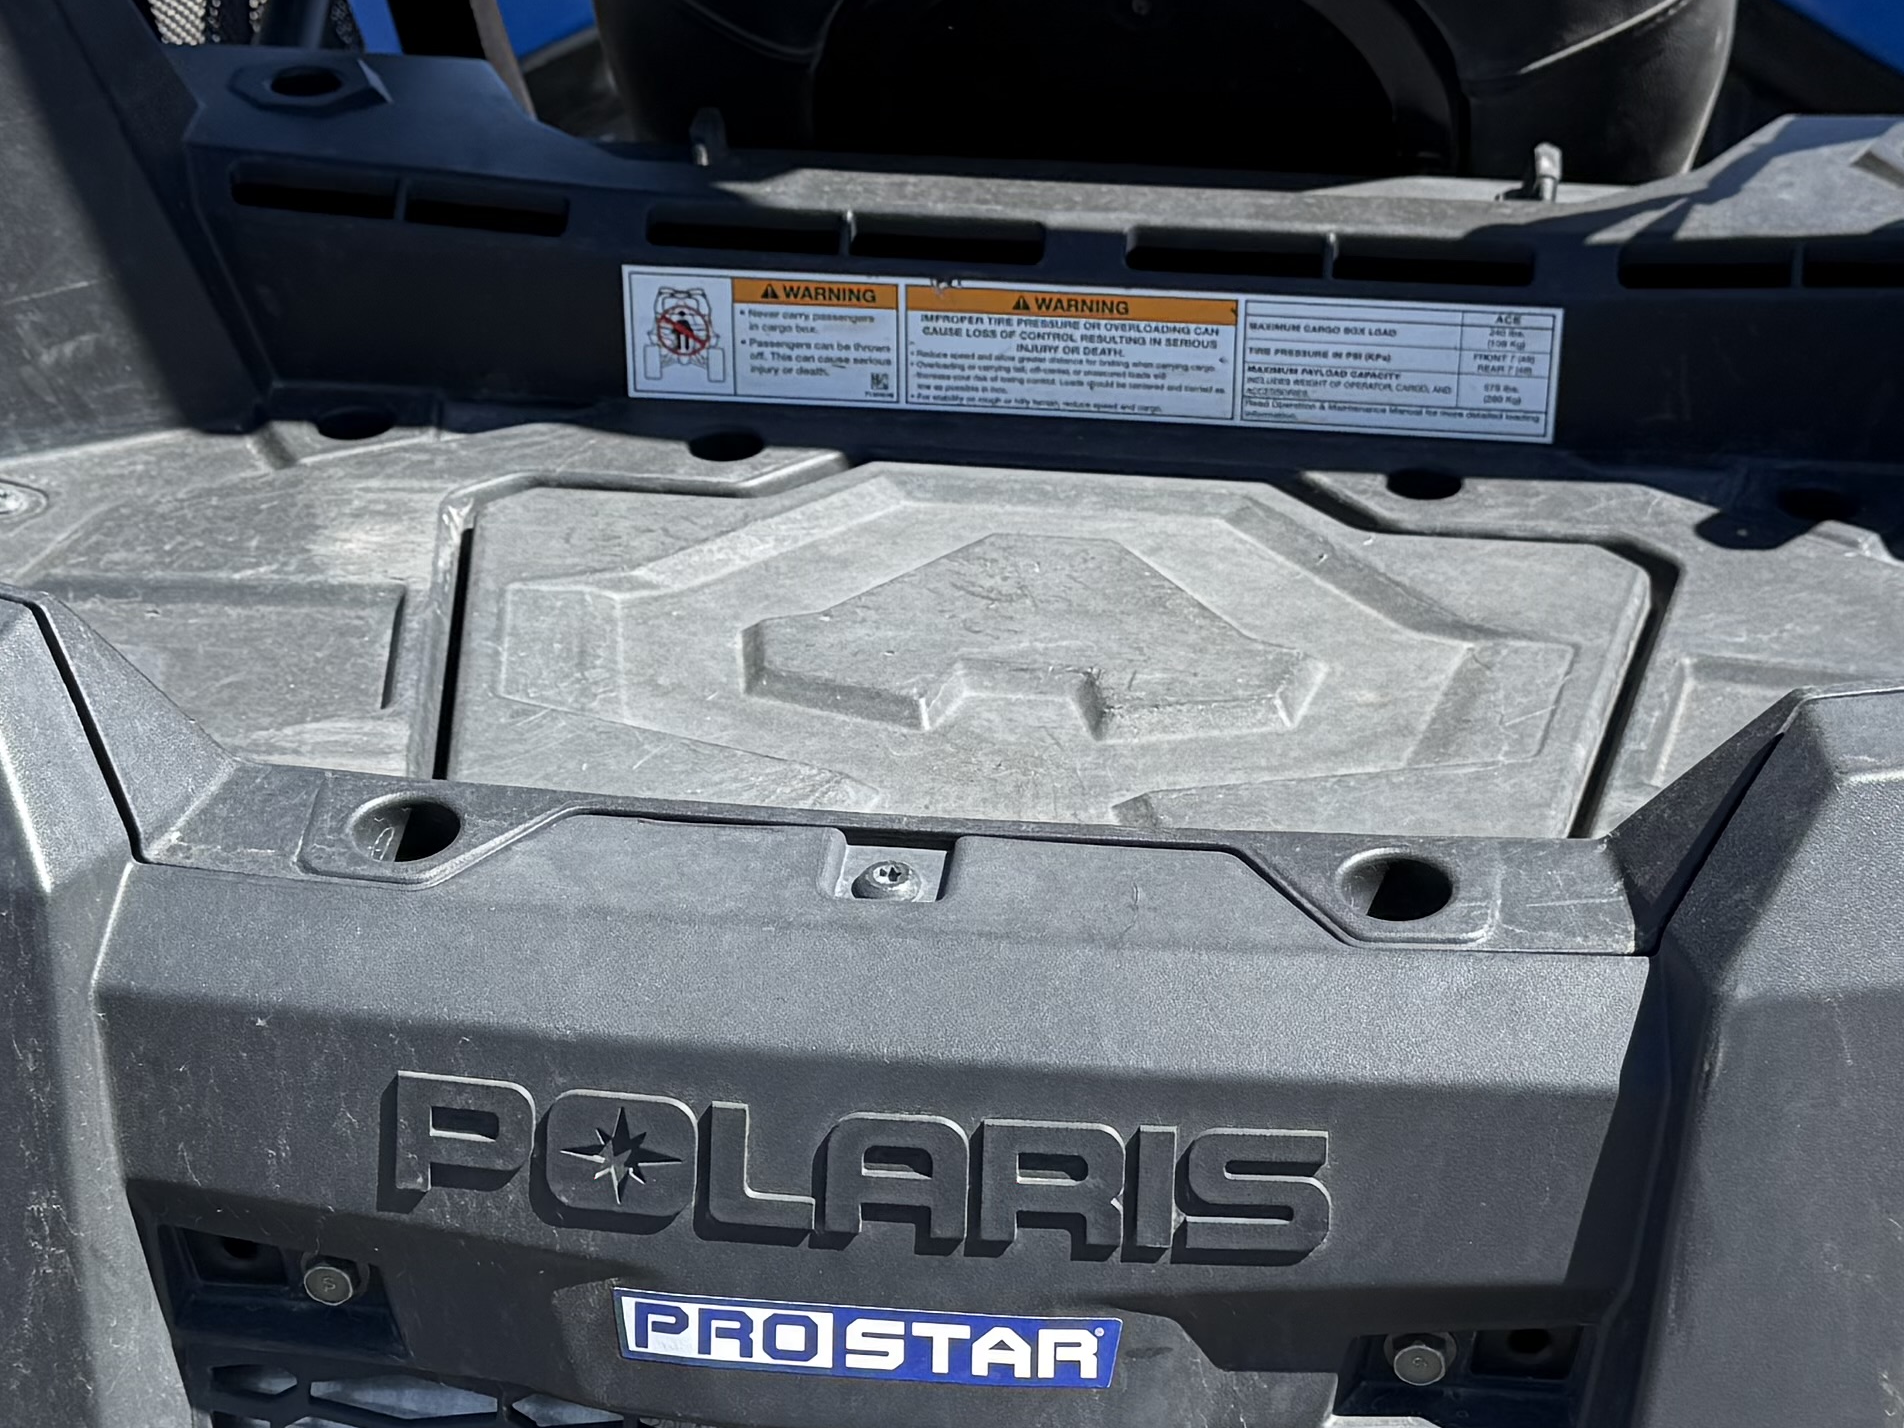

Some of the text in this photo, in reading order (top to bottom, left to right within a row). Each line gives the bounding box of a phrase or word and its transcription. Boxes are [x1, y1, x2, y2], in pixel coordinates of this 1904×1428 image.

[782, 283, 876, 303] WARNING
[1035, 295, 1129, 316] WARNING
[921, 313, 1220, 337] IMPROPER TIRE PRESSURE OR OVERLOADING CAN
[1495, 314, 1522, 325] ACE
[922, 326, 1218, 350] CAUSE LOSS OF CONTROL RESULTING IN SERIOUS
[1249, 322, 1398, 338] MAXIMUM CARGO BOX LOAD
[1015, 343, 1126, 358] INJURY OR DEATH.
[1248, 365, 1401, 381] MAXIMUM PAYLOAD CAPACITY
[378, 1070, 1332, 1267] POLARIS
[635, 1301, 1104, 1379] PROSTAR
